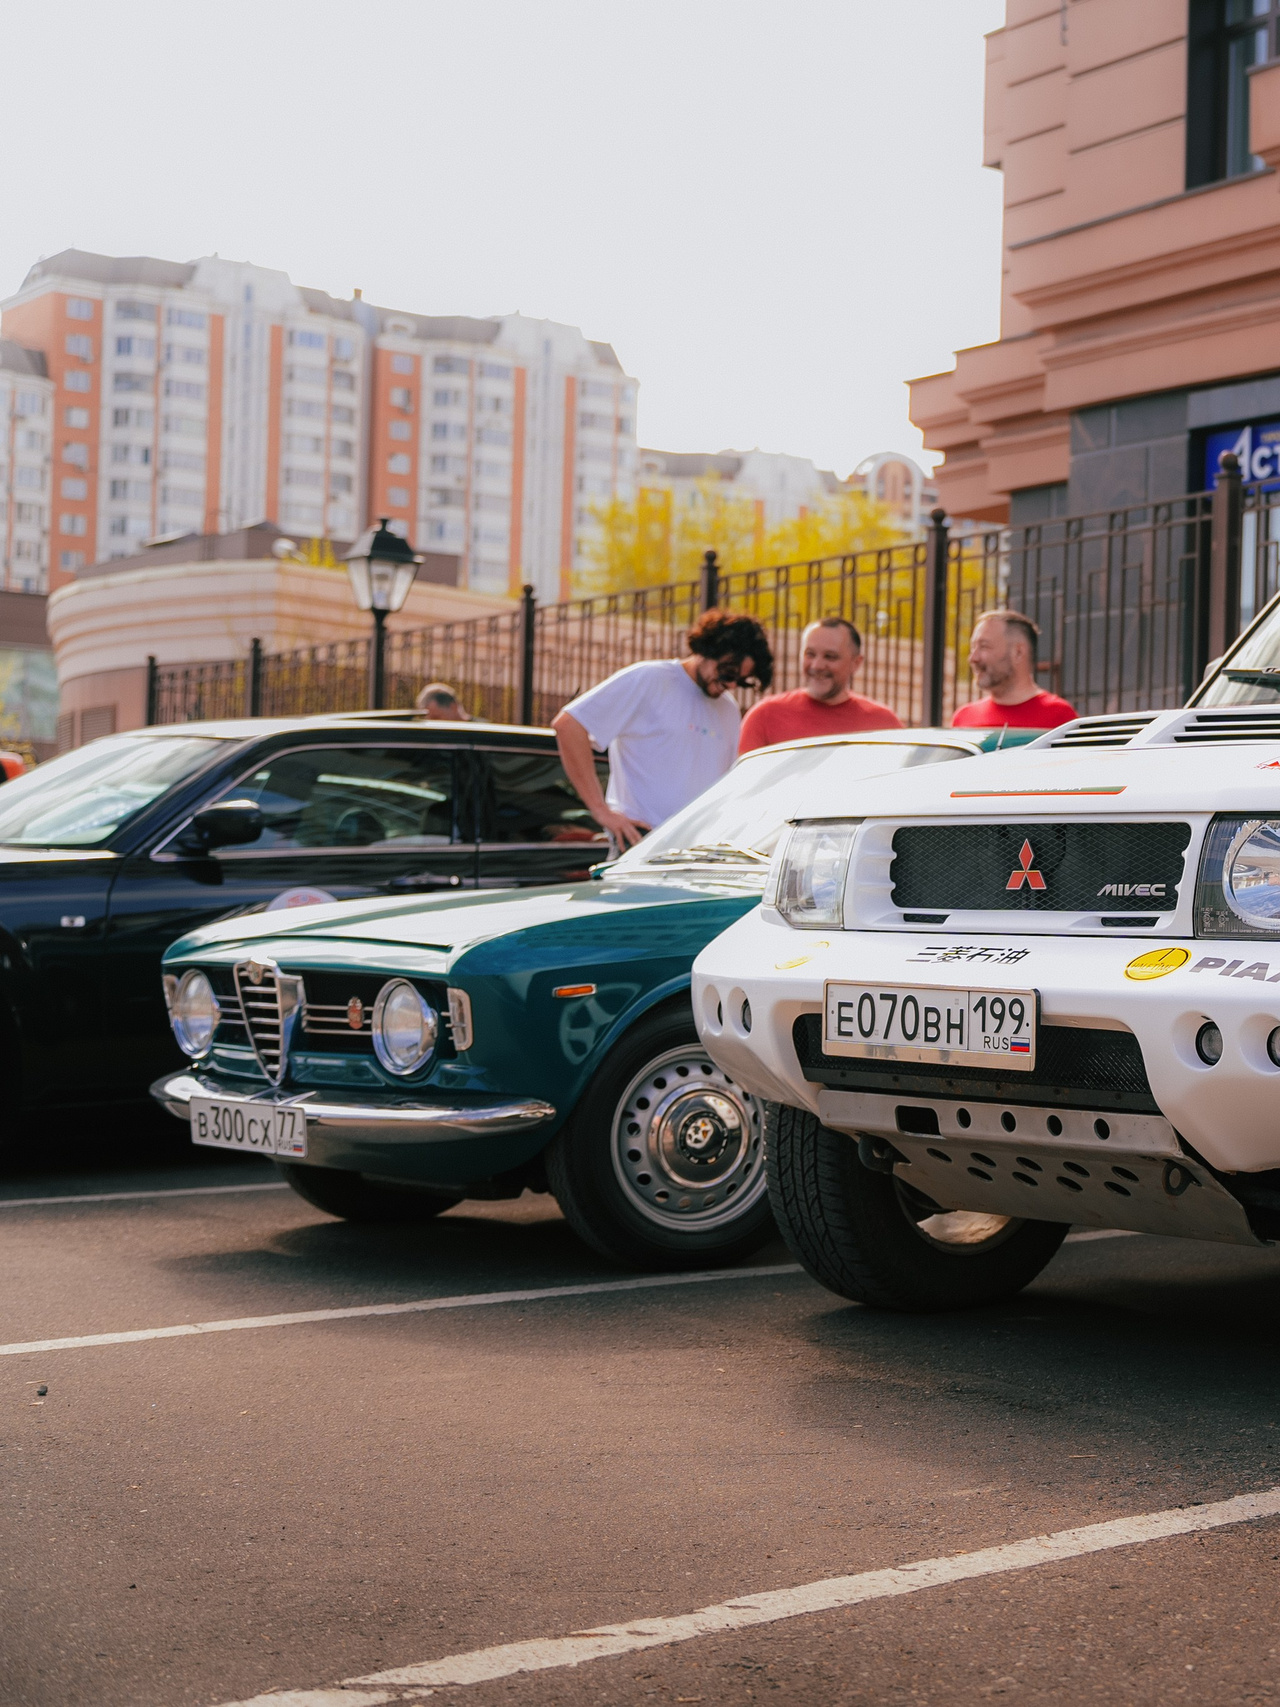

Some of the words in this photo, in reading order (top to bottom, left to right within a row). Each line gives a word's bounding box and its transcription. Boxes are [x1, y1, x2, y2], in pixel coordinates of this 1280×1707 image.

[1097, 884, 1167, 896] MIVEC
[905, 946, 1031, 965] 三菱石油
[972, 996, 1025, 1034] 199
[983, 1035, 1009, 1050] RUS
[277, 1111, 296, 1139] 77
